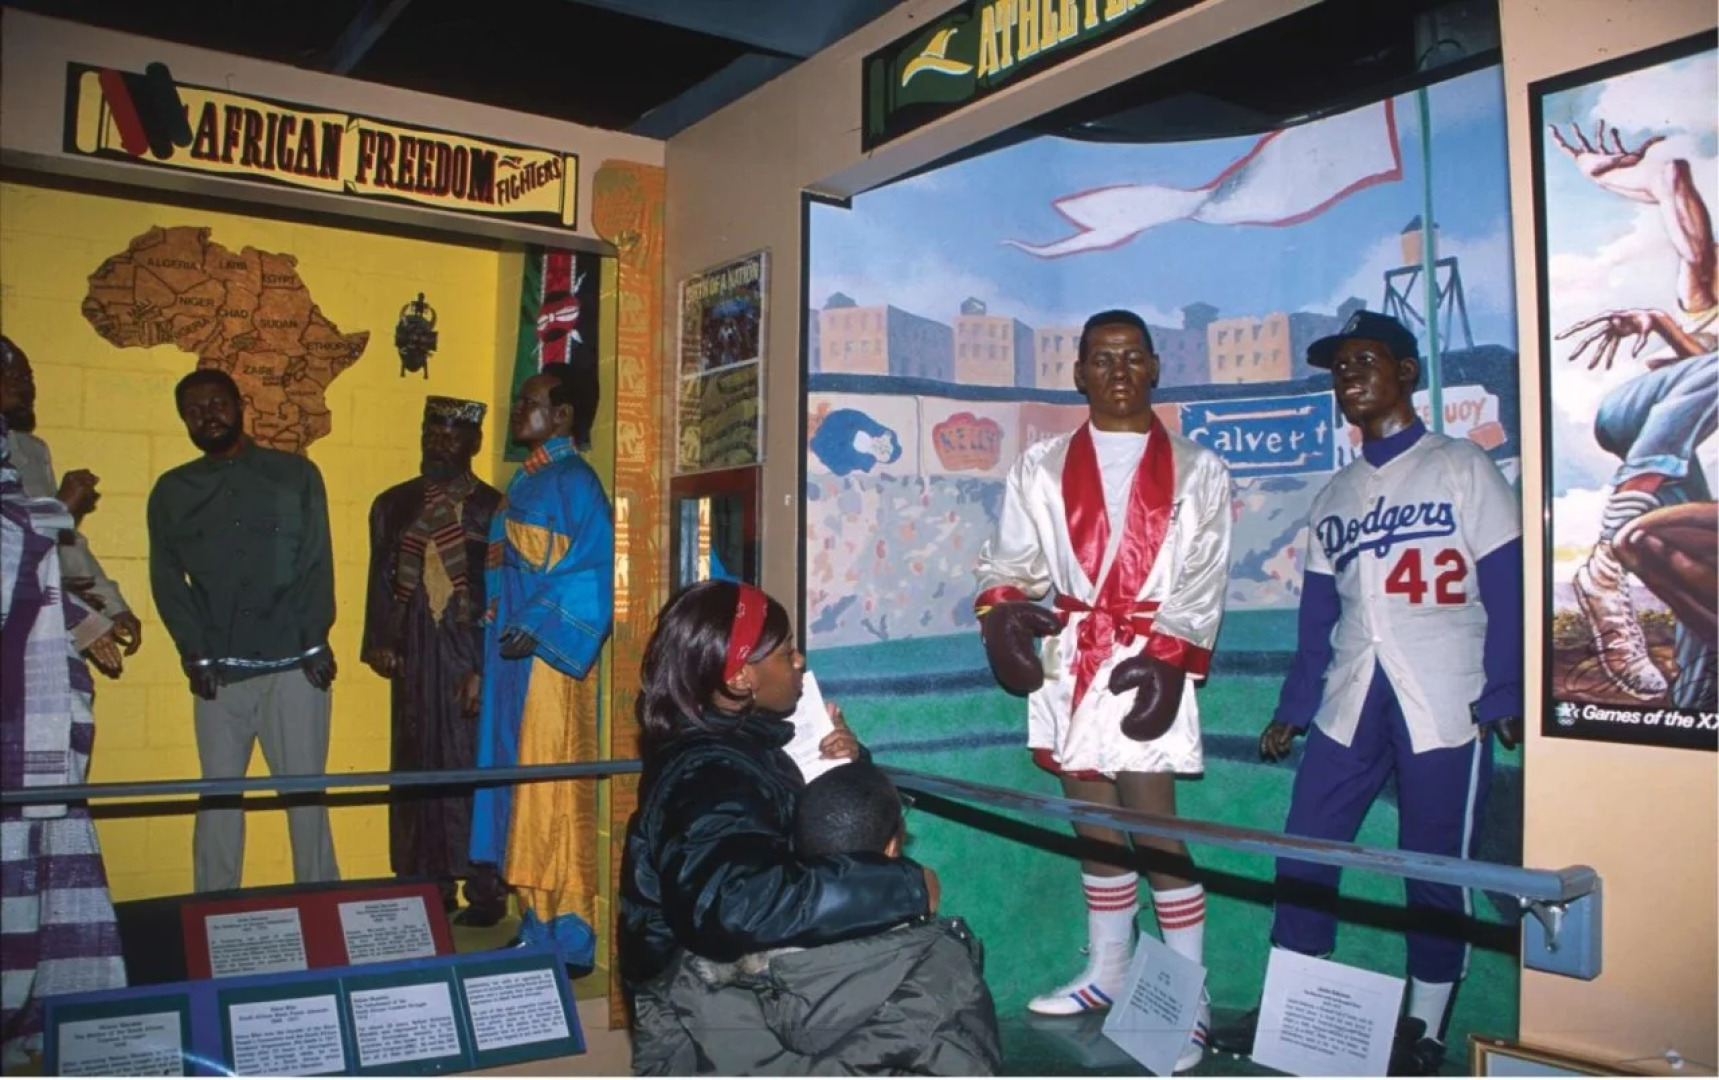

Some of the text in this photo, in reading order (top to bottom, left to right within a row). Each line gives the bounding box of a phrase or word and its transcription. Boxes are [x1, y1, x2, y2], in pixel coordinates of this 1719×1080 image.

[978, 0, 1146, 79] ATHLE
[190, 101, 562, 207] AFRICAN FREEDOM FIGHTERS
[1316, 496, 1456, 566] Dodgers
[1385, 548, 1468, 604] 42
[1583, 705, 1641, 723] Games
[1643, 710, 1665, 725] of
[1665, 711, 1694, 728] the
